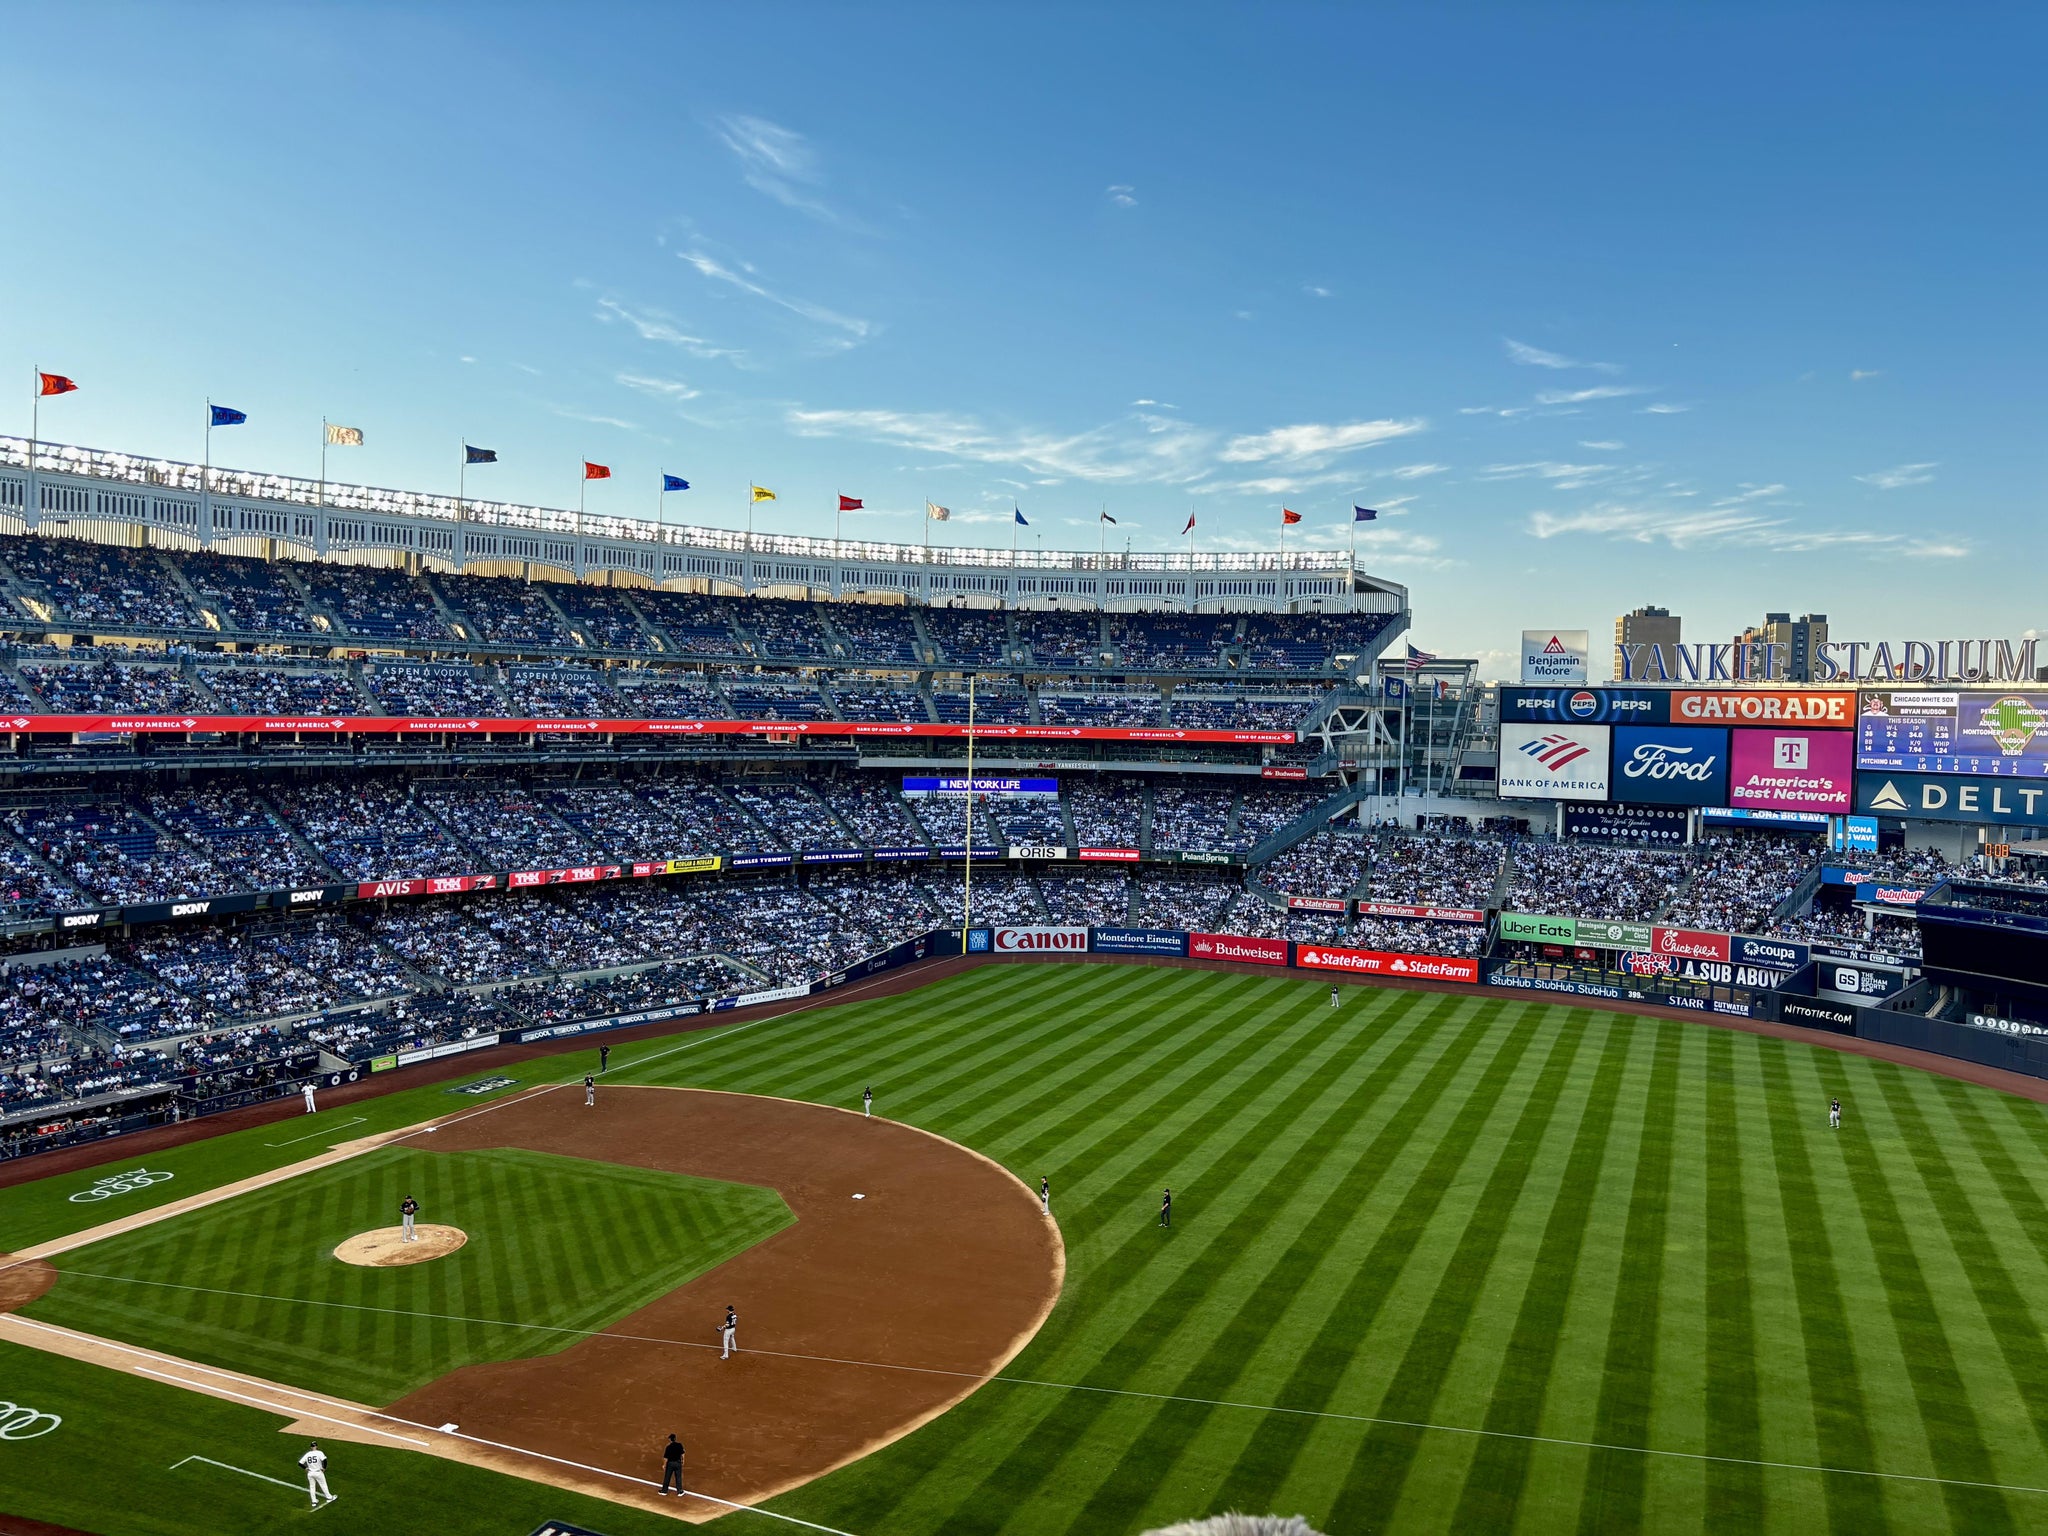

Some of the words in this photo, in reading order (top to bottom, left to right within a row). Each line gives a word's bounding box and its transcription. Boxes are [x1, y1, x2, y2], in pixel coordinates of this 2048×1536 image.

[1528, 656, 1580, 667] Benjamin
[1615, 642, 1790, 681] YANKEE
[1814, 638, 2040, 682] STADIUM
[382, 666, 420, 676] ASPEN
[433, 668, 470, 677] VODKA
[515, 672, 548, 680] ASPEN
[560, 672, 592, 681] VODKA
[1534, 666, 1572, 675] Moore
[1517, 699, 1555, 708] PEPSI
[1612, 700, 1651, 710] PEPSI
[1680, 696, 1847, 720] GATORADE
[1624, 744, 1716, 781] Ford
[950, 780, 971, 788] NEW
[973, 780, 1000, 789] YORK
[1001, 781, 1020, 789] LIFE
[1502, 778, 1532, 787] BANK
[1536, 779, 1549, 788] OF
[1552, 780, 1604, 790] AMERICA
[1747, 775, 1832, 789] America's
[1734, 786, 1770, 798] Best
[1773, 788, 1847, 803] Network
[1922, 784, 2043, 815] DELT
[1708, 807, 1733, 816] WAVE
[1780, 811, 1797, 820] BIG
[1799, 812, 1826, 822] WAVE
[1020, 848, 1056, 858] ORIS
[1985, 843, 2009, 858] 0:08
[1182, 852, 1205, 861] Poland
[1206, 854, 1229, 864] Spring
[374, 882, 410, 896] AVIS
[64, 914, 100, 927] DKNY
[172, 902, 210, 915] DKNY
[291, 890, 324, 903] DKNY
[1504, 920, 1536, 934] Uber
[1539, 924, 1572, 938] Eats
[1578, 921, 1607, 930] Morningside
[1623, 925, 1648, 933] Workmen's
[996, 930, 1085, 949] Canon
[1097, 932, 1145, 942] Montefiore
[1146, 934, 1181, 944] Einstein
[1216, 942, 1282, 960] Budweiser
[1760, 945, 1795, 960] coupa
[1628, 952, 1671, 965] Jersey
[1684, 960, 1694, 976] A
[1700, 962, 1731, 982] SUB
[1839, 974, 1855, 985] GS
[1861, 977, 1887, 986] GOTHAM
[1491, 976, 1531, 988] StubHub
[1534, 980, 1575, 993] StubHub
[1578, 985, 1618, 998] StubHub
[1668, 996, 1704, 1009] STARR
[1714, 1001, 1749, 1012] CUTWATER
[1784, 1004, 1852, 1026] NITTOTIRE.COM
